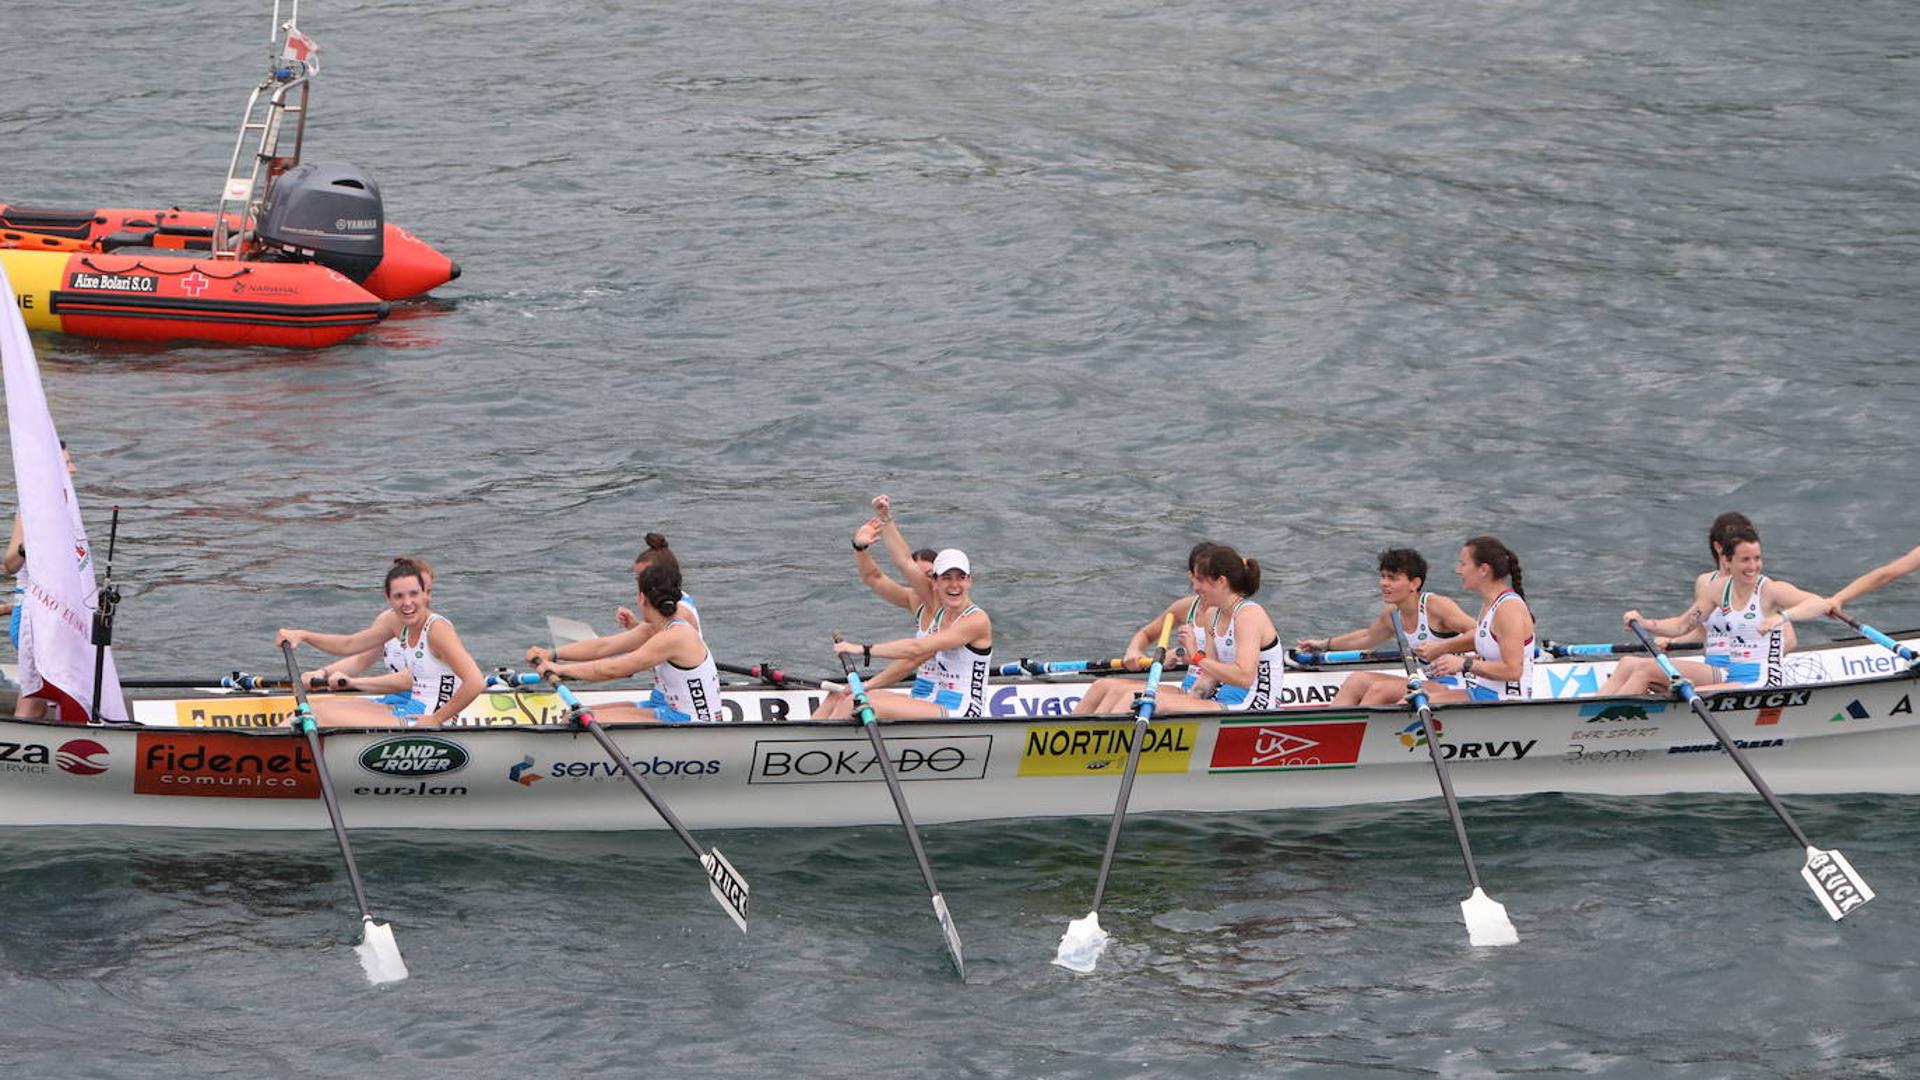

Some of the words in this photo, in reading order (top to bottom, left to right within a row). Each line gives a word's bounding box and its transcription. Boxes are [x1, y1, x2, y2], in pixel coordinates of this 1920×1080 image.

[346, 219, 377, 230] YAMAHA
[74, 273, 99, 288] Aixe
[100, 275, 131, 290] Bolari
[131, 277, 153, 291] S.O.
[1027, 728, 1190, 757] NORTINDAL
[147, 744, 312, 773] fidenet
[380, 746, 435, 759] LAND
[383, 759, 451, 771] ROVER
[160, 775, 297, 787] comunica
